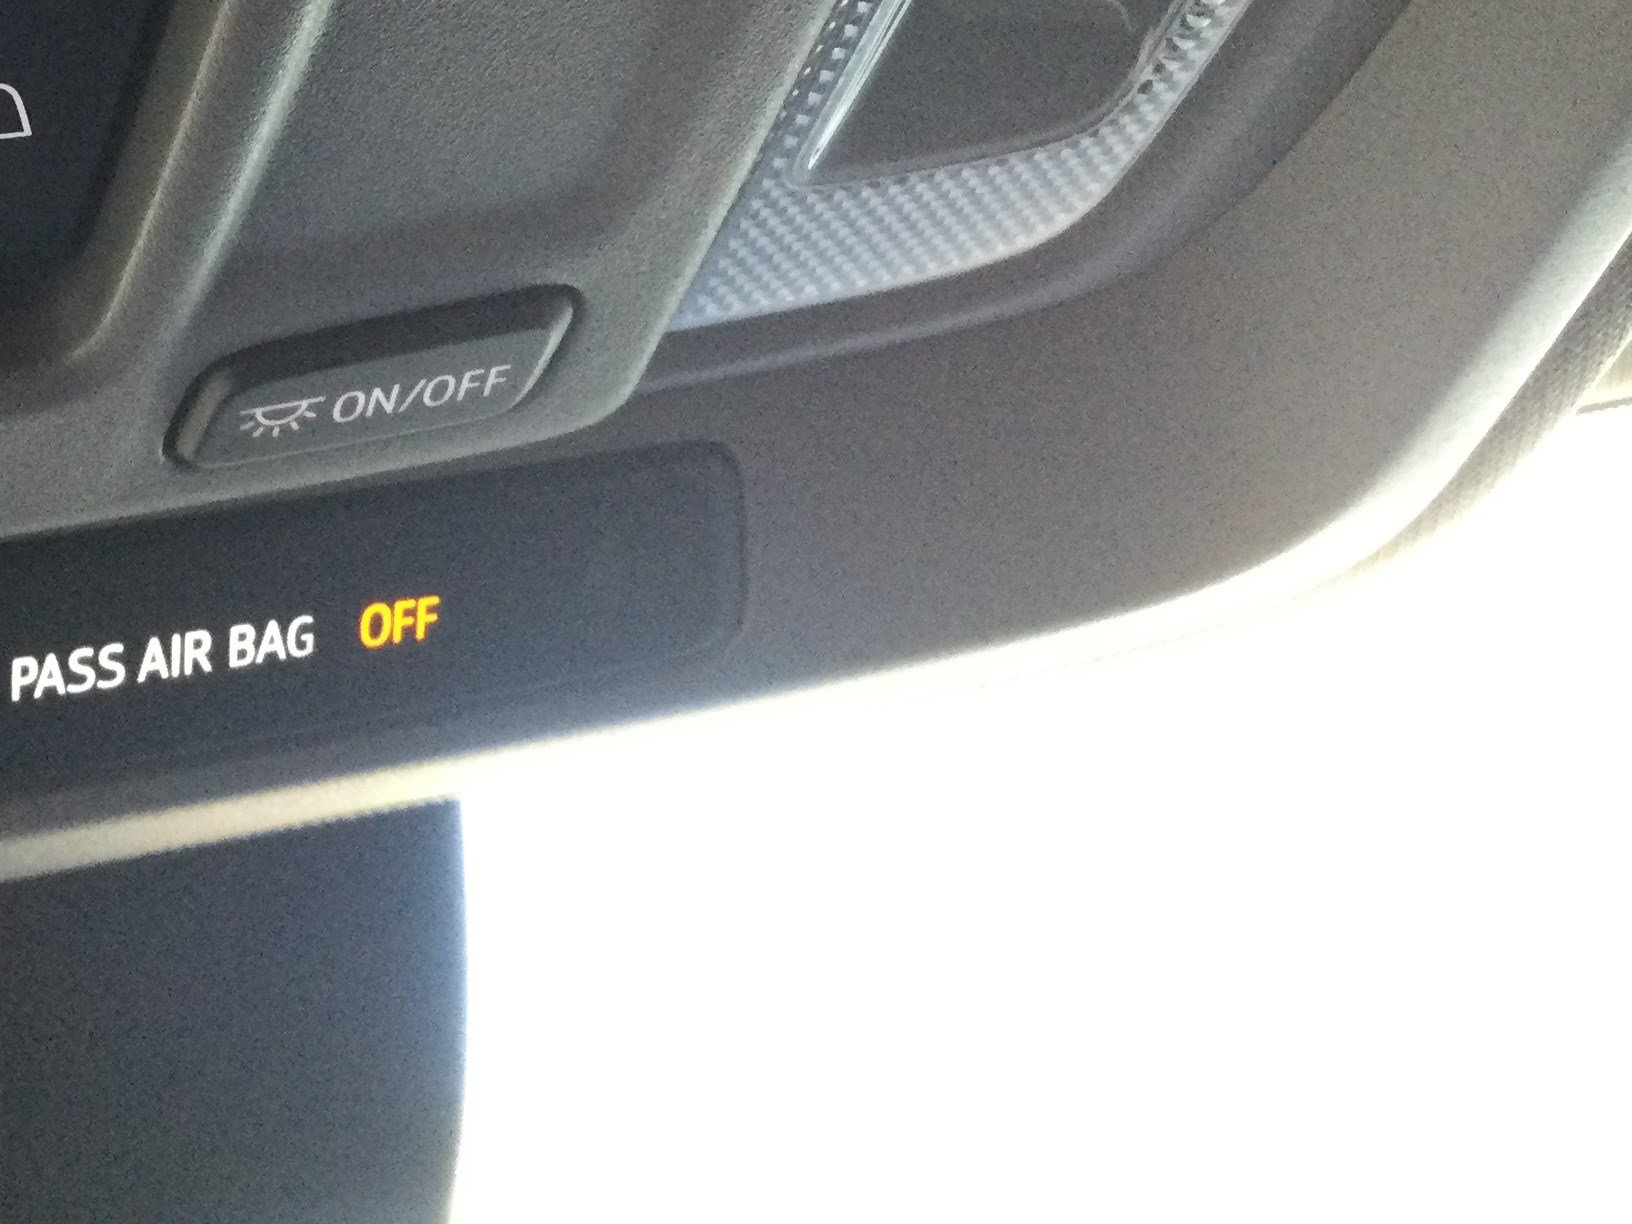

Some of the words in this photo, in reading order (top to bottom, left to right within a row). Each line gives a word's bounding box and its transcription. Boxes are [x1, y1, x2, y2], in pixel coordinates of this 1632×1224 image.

[331, 364, 512, 423] ON/OFF
[9, 641, 128, 703] PASS
[136, 629, 214, 684] AIR
[227, 614, 316, 669] BAG
[357, 594, 442, 650] OFF
